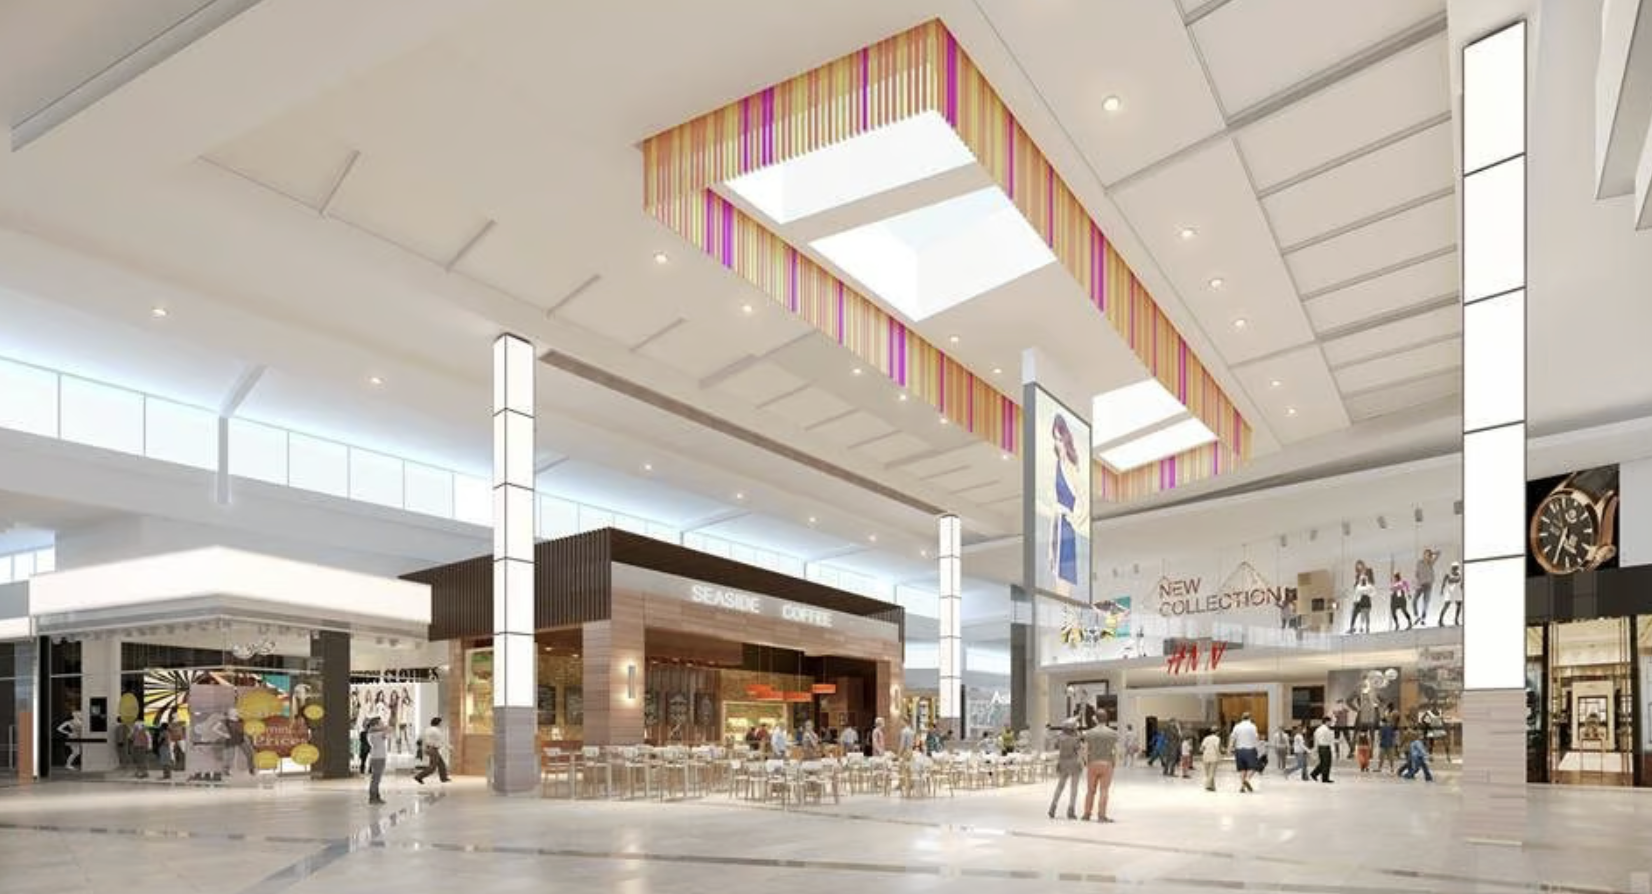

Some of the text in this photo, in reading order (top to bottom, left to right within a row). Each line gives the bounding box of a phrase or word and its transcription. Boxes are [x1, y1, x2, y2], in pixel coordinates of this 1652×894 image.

[1159, 578, 1201, 598] NEW
[1159, 586, 1282, 616] COLLECTION
[692, 585, 834, 628] SEASIDE COFFEE
